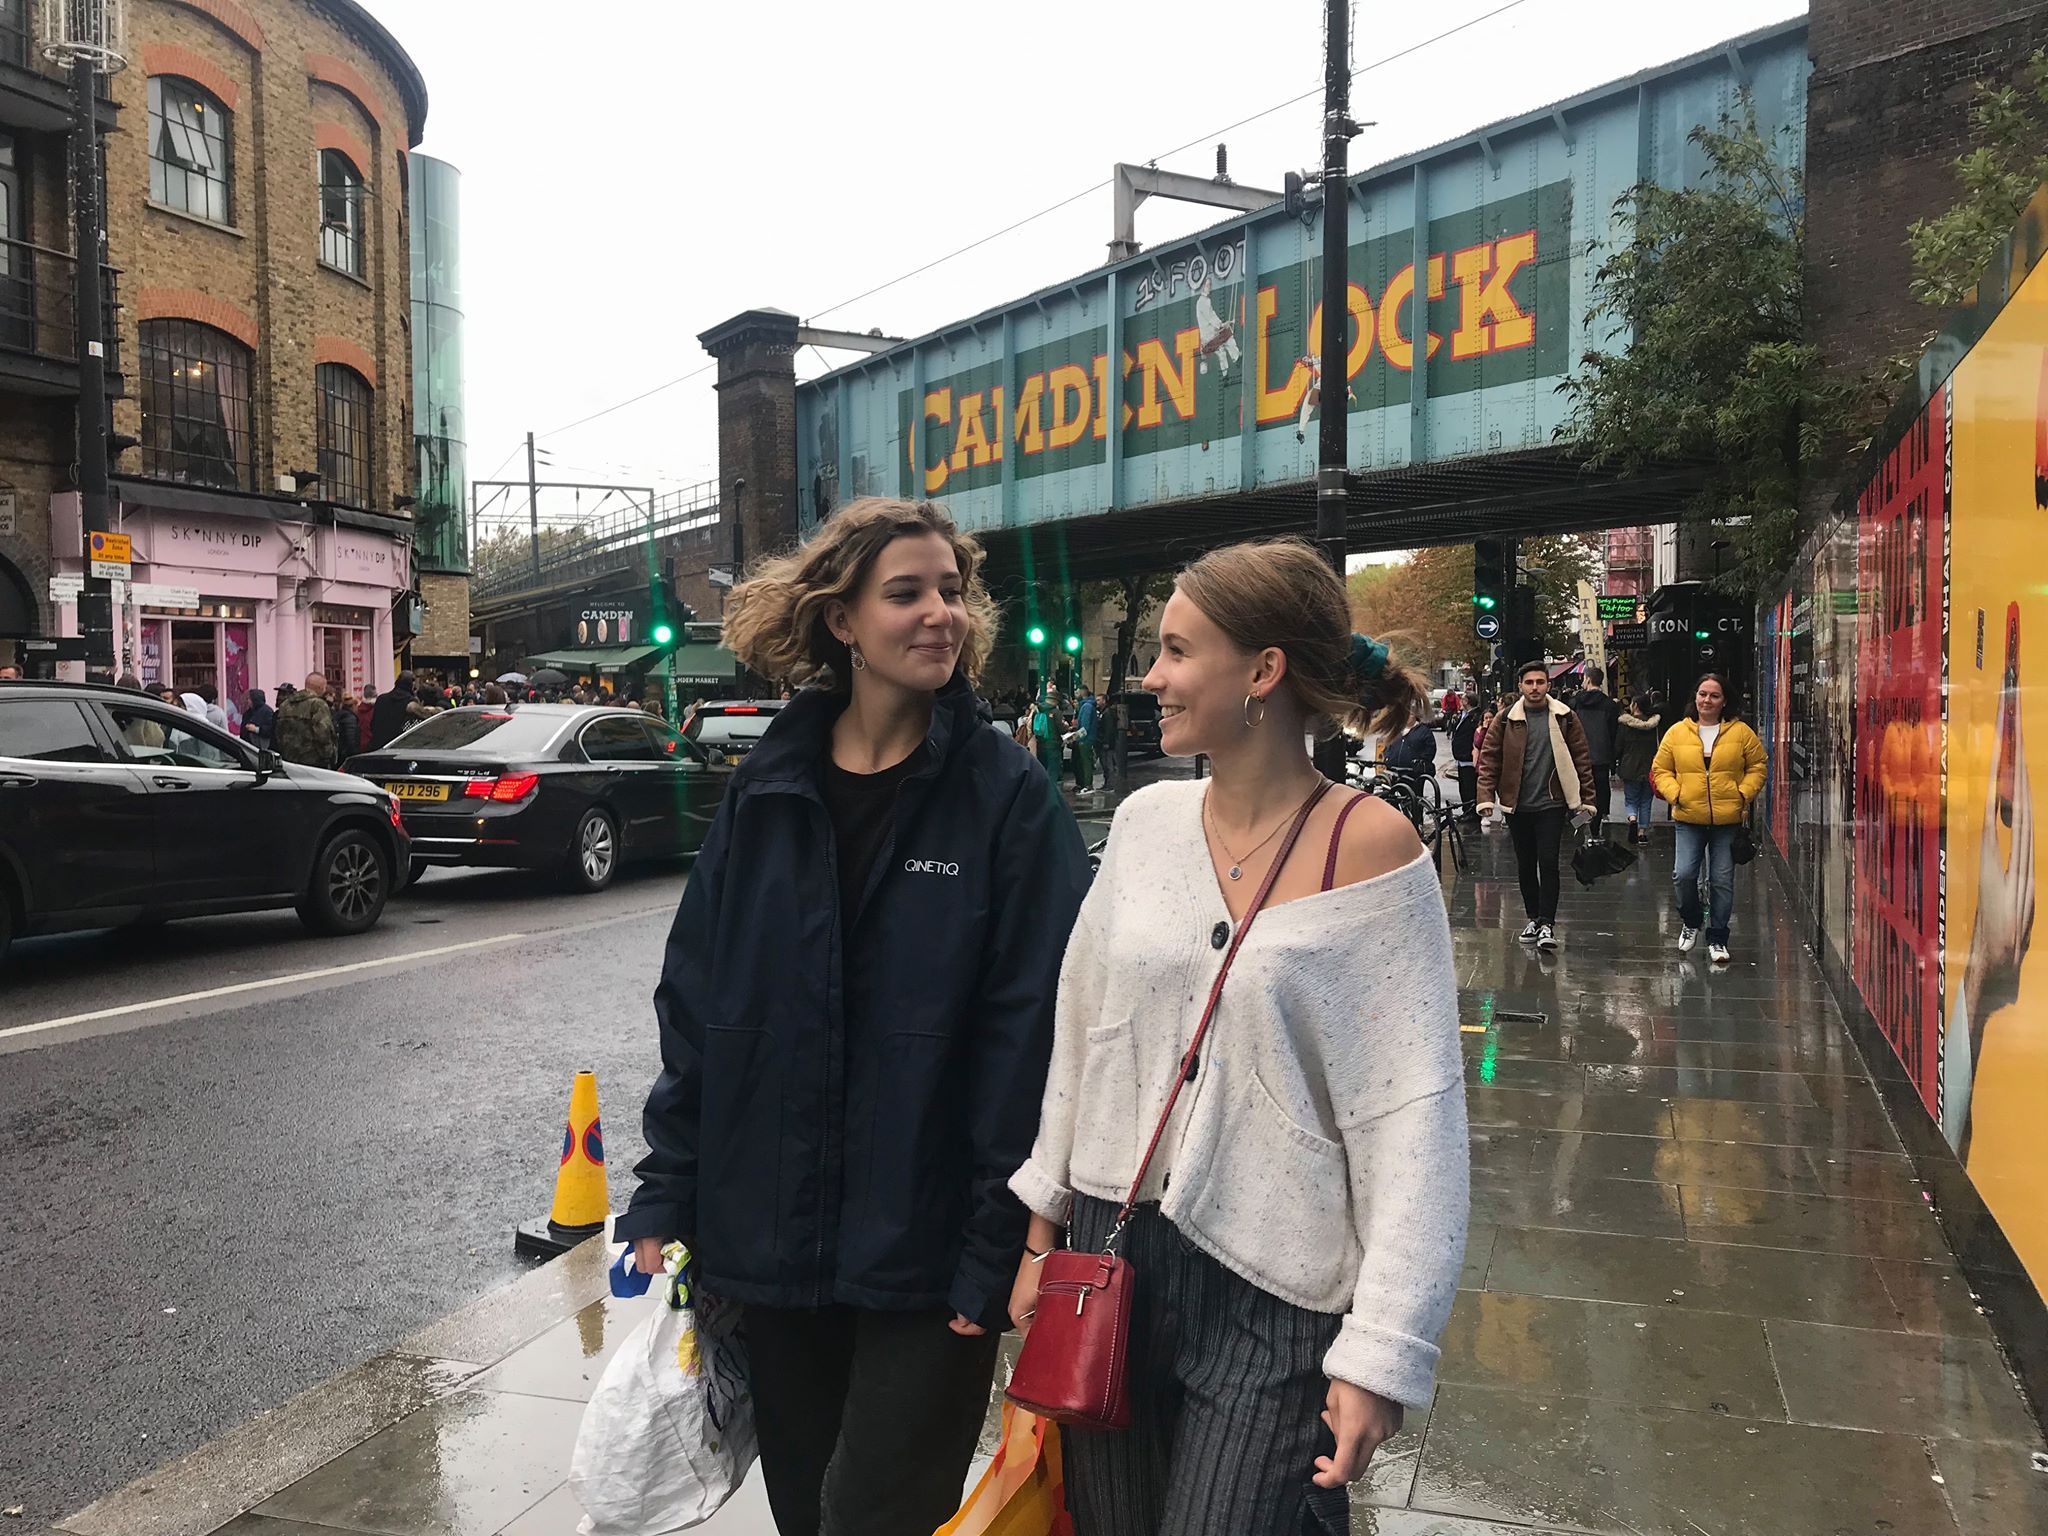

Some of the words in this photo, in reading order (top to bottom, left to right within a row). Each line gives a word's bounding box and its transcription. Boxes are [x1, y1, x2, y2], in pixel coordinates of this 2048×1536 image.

[909, 326, 1200, 494] CAMDEN
[1241, 229, 1537, 426] LOCK
[581, 610, 634, 621] CAMDEN
[1942, 511, 1951, 636] WHARF
[695, 677, 719, 685] MARKET
[407, 784, 415, 796] D
[417, 784, 441, 797] 296
[905, 859, 959, 876] QINETIQ
[1938, 849, 1947, 995] CAMDEN
[1861, 892, 1924, 1088] CAMDEN
[1936, 1010, 1945, 1133] WHARF
